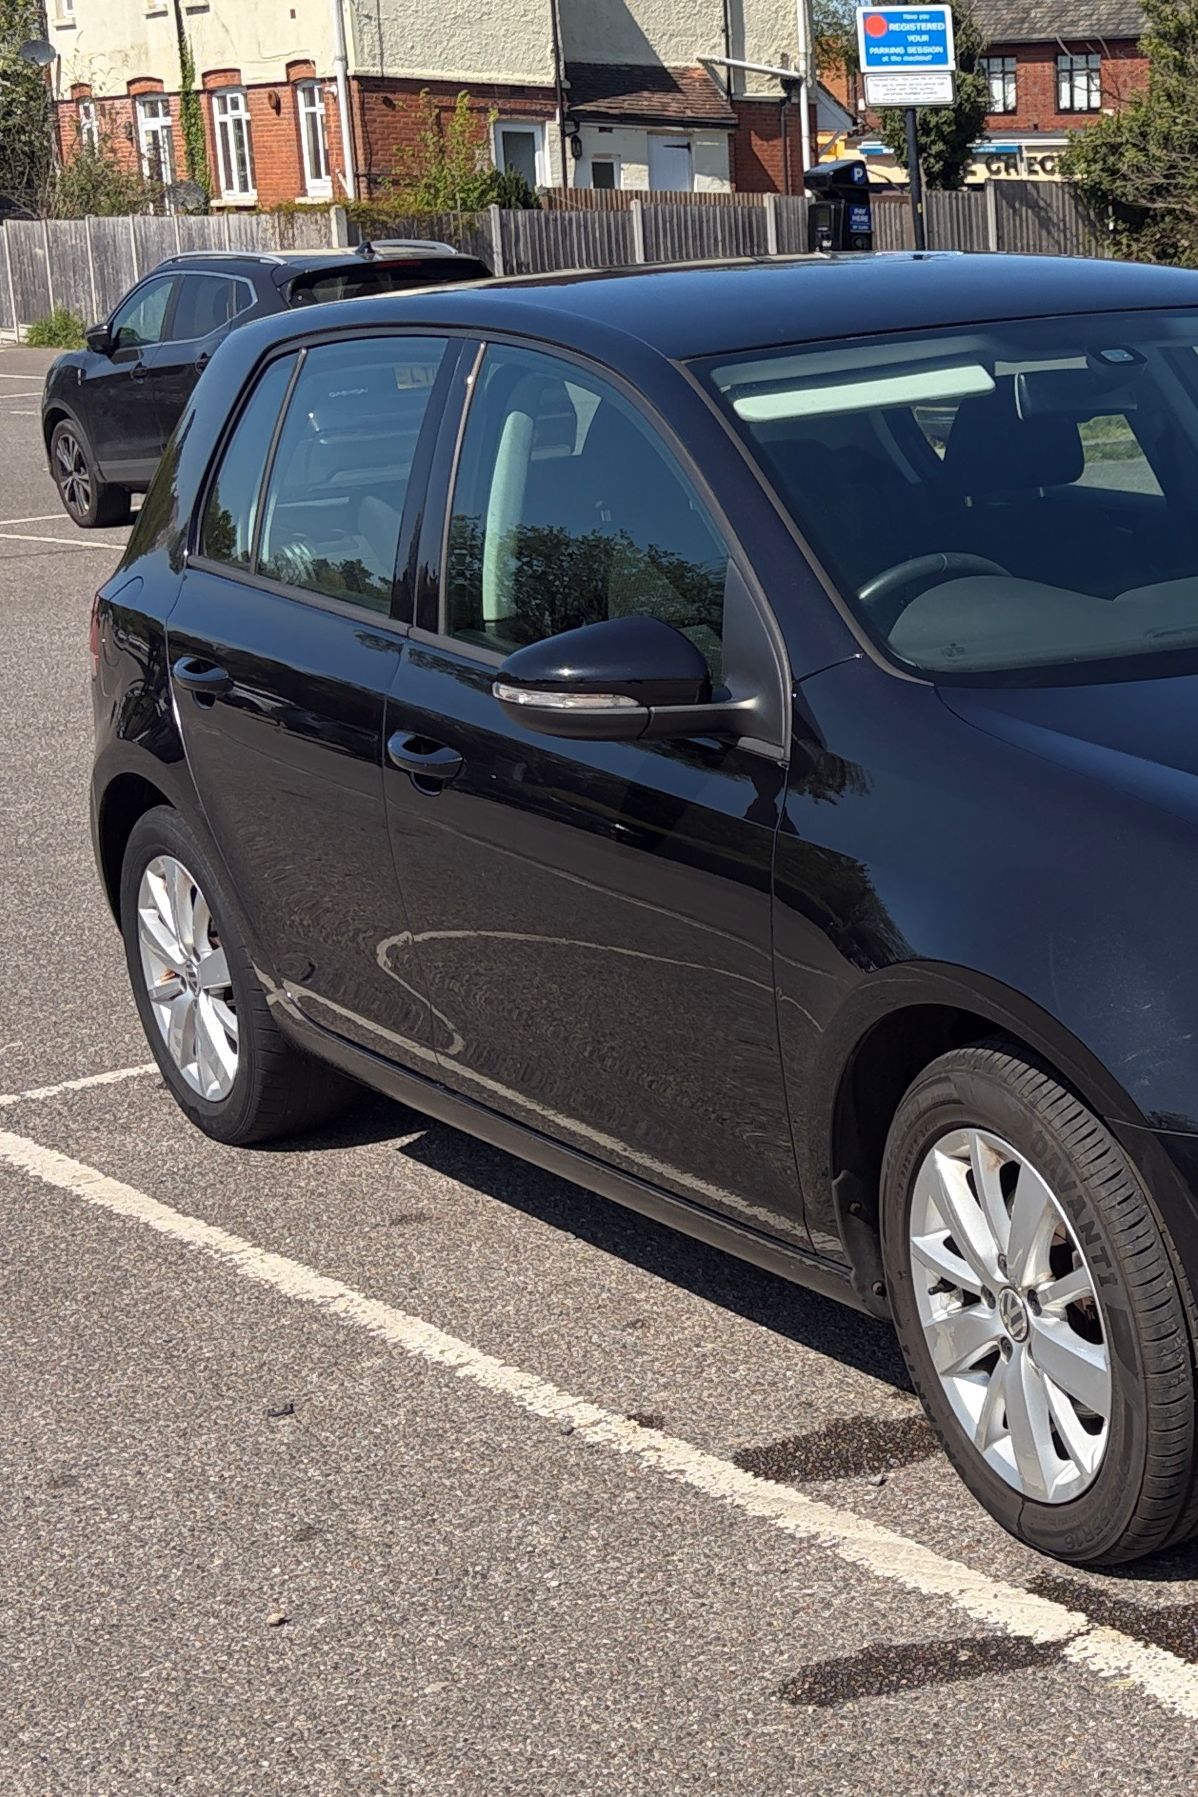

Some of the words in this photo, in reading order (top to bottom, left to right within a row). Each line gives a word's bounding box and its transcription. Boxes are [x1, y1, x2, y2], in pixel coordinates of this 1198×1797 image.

[888, 22, 946, 31] REGISTERED
[907, 34, 930, 43] YOUR
[869, 46, 905, 55] PARKING
[906, 45, 944, 54] SESSION
